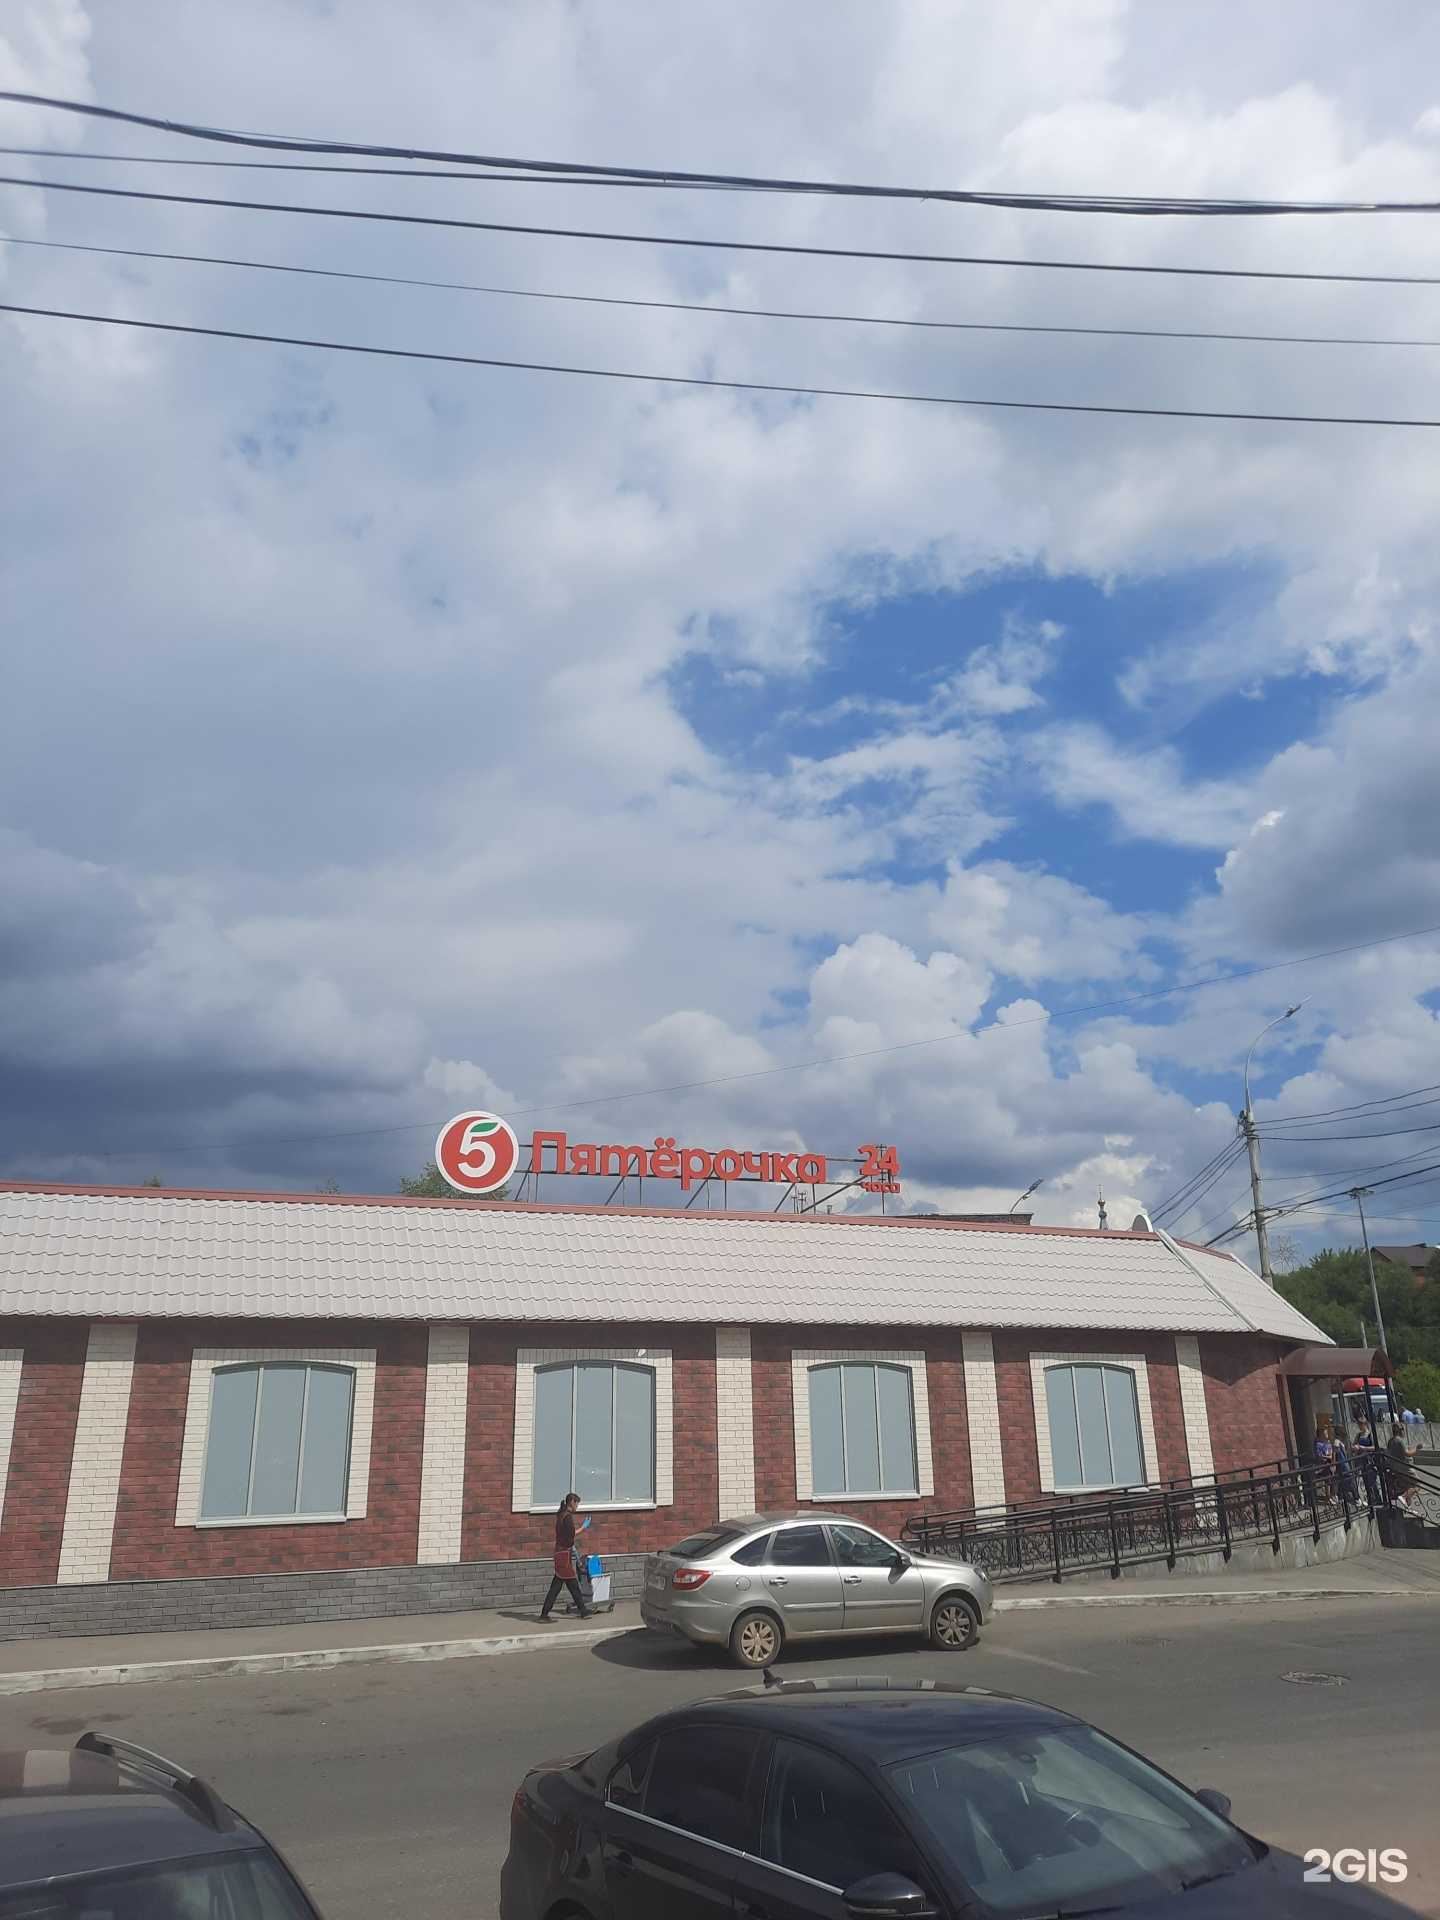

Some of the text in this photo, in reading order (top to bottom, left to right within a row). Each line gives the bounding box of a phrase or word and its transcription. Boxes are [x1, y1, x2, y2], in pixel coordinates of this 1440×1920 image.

[457, 1119, 826, 1191] 5 Пятёрочка
[857, 1144, 901, 1176] 24
